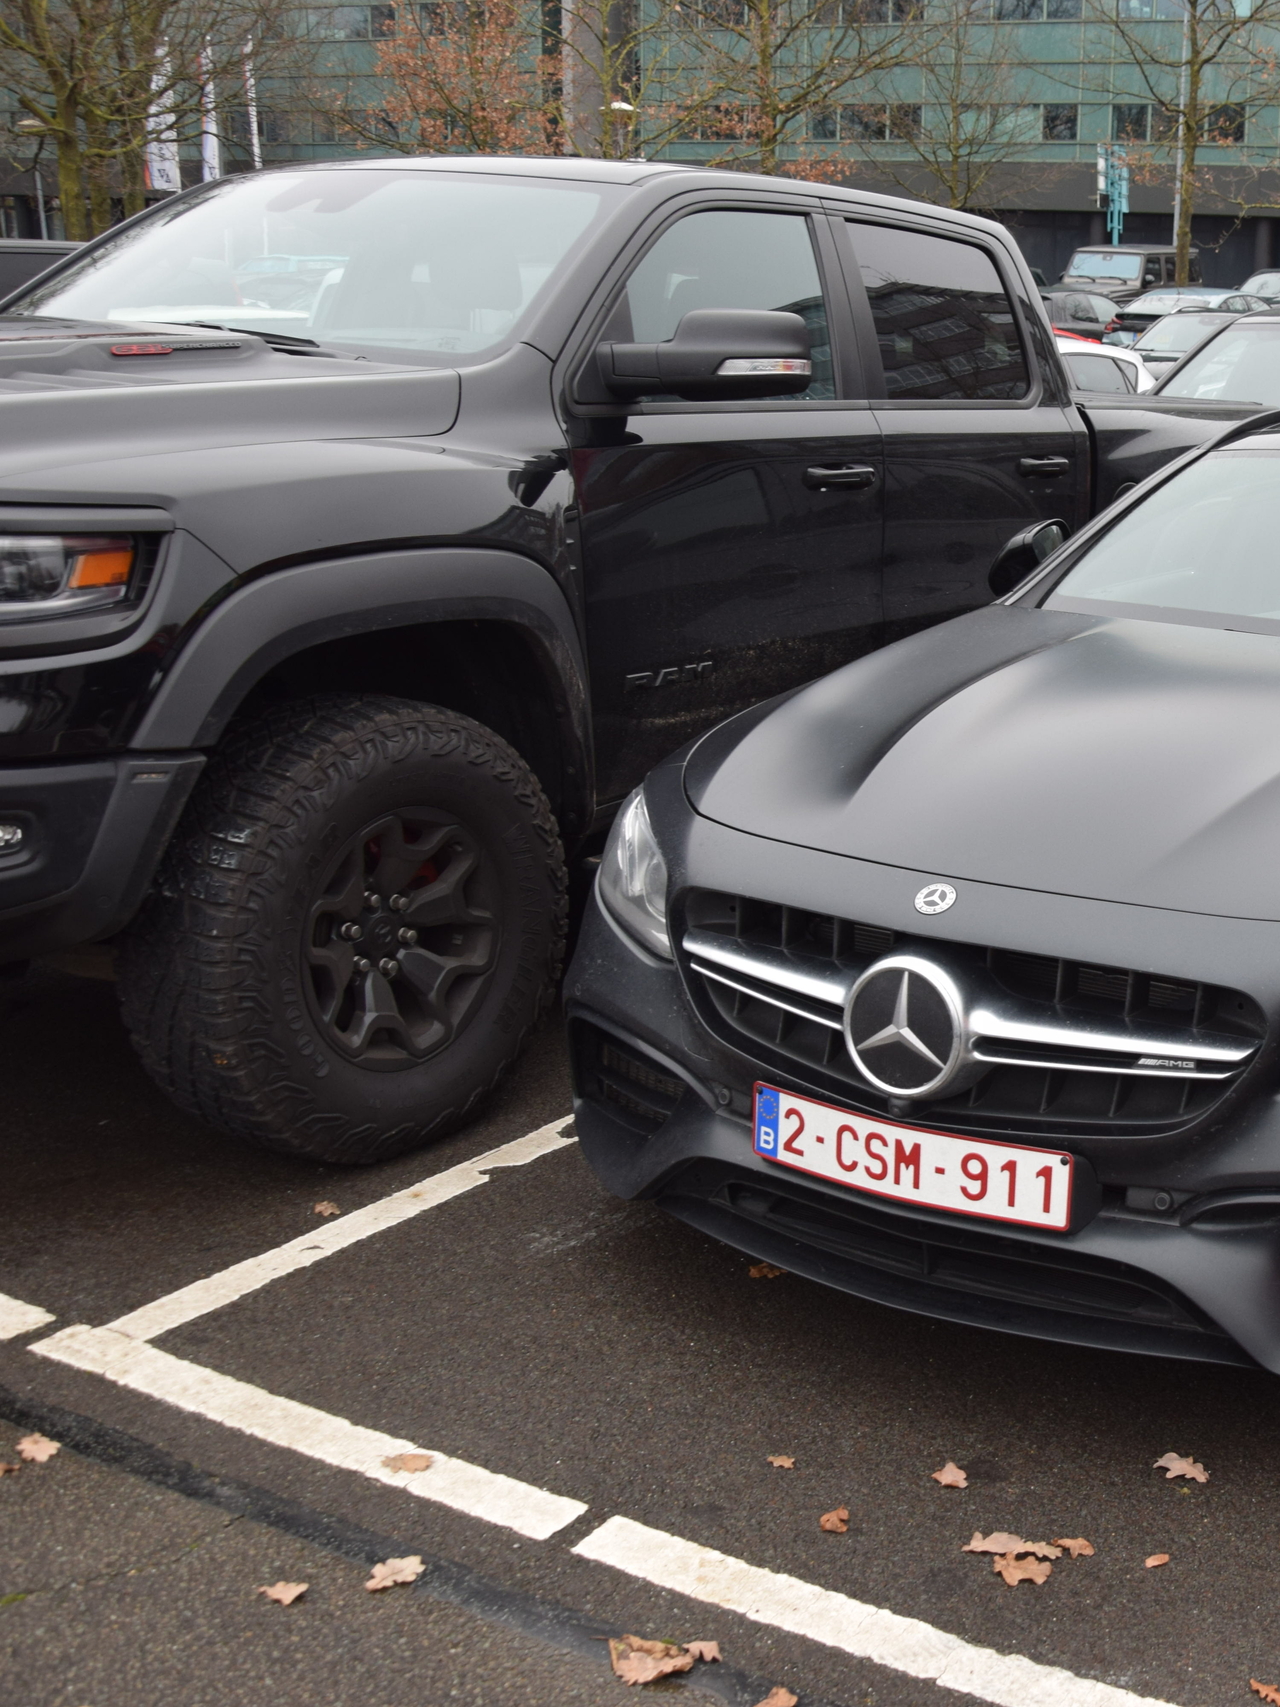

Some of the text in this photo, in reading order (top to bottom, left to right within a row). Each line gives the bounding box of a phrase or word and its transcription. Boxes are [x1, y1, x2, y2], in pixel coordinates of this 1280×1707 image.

[624, 661, 713, 691] RAM
[494, 822, 543, 1034] WRANGLER
[1156, 1059, 1195, 1068] AMG
[759, 1126, 775, 1150] B
[782, 1107, 1053, 1214] 2-CSM-911
